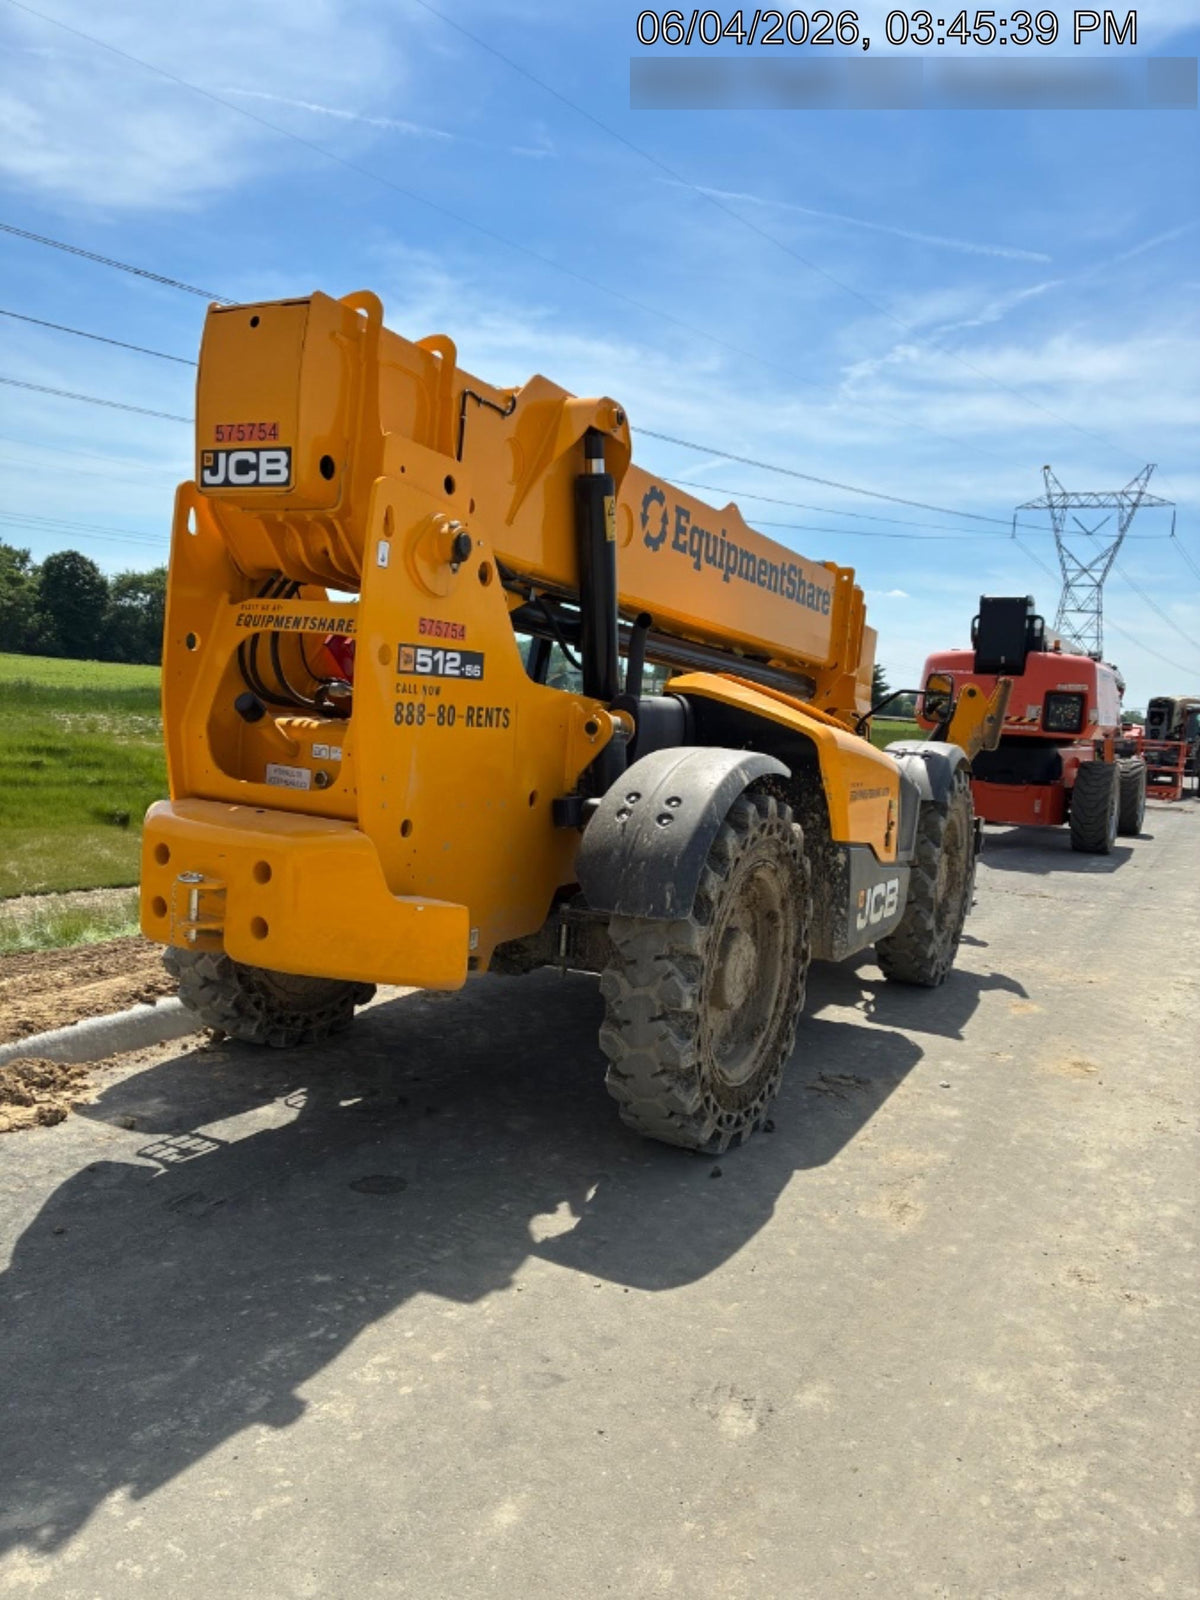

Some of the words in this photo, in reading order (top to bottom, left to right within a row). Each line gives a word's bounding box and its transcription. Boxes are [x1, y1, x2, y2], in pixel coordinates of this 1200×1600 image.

[215, 423, 278, 441] 575754
[203, 450, 289, 484] JCB
[671, 505, 831, 616] EquipmentShare
[419, 618, 466, 640] 575754
[396, 683, 417, 695] CALL
[422, 684, 441, 696] NOW
[394, 702, 511, 729] 888-80-RENTS
[856, 878, 899, 931] JCB
